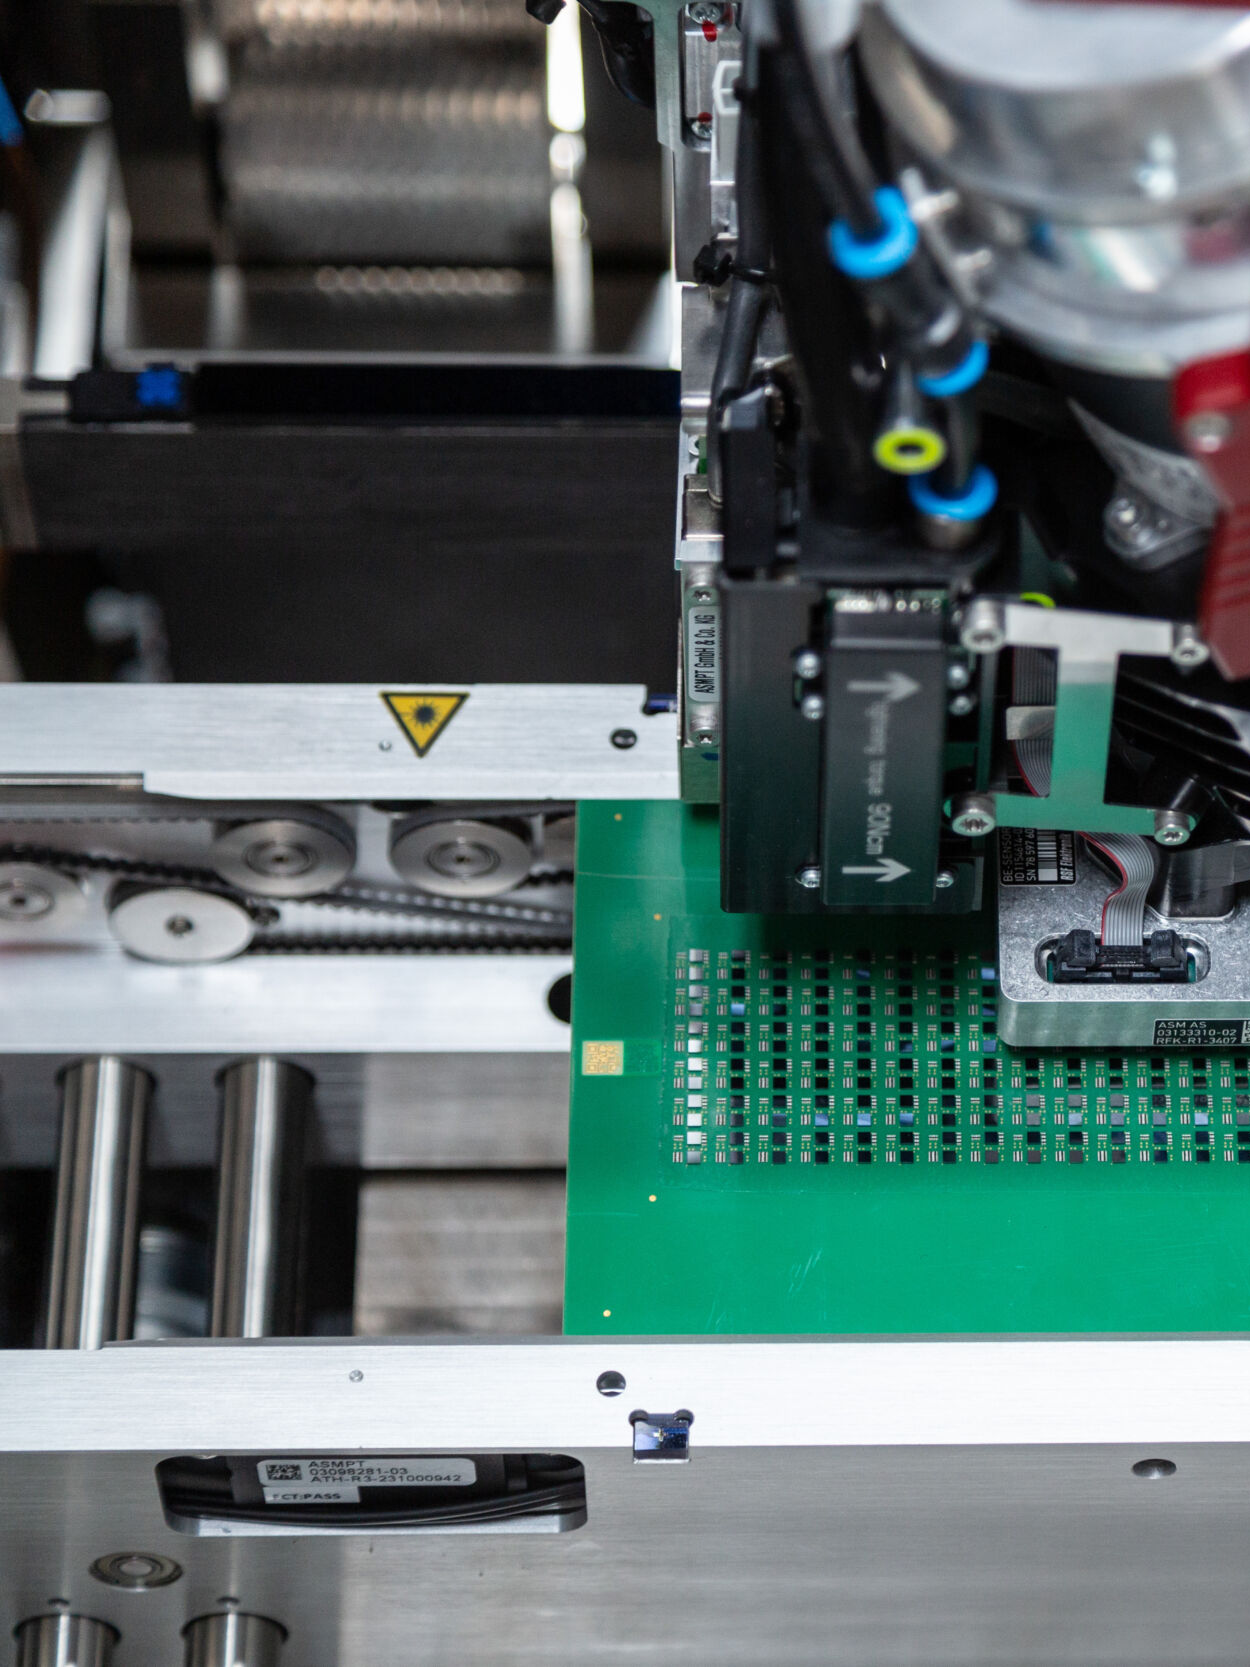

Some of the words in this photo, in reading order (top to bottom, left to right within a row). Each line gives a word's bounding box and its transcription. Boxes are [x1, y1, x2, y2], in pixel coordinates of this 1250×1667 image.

[694, 614, 715, 624] KG
[694, 627, 715, 638] Co.
[694, 647, 715, 668] GmbH
[694, 669, 715, 694] ASMPT
[866, 802, 892, 855] 90Ncm
[1024, 840, 1036, 856] 597
[1025, 856, 1036, 867] 78
[1026, 869, 1037, 881] SN
[1060, 867, 1074, 881] RSF
[1158, 1021, 1186, 1029] ASM
[1190, 1021, 1208, 1029] AS
[1156, 1029, 1237, 1037] 03133310-02
[1156, 1037, 1238, 1045] RFK-R1-3407
[308, 1460, 366, 1469] ASMPT
[309, 1467, 409, 1476] 03098281-03
[311, 1475, 462, 1484] ATH-R3-231000942
